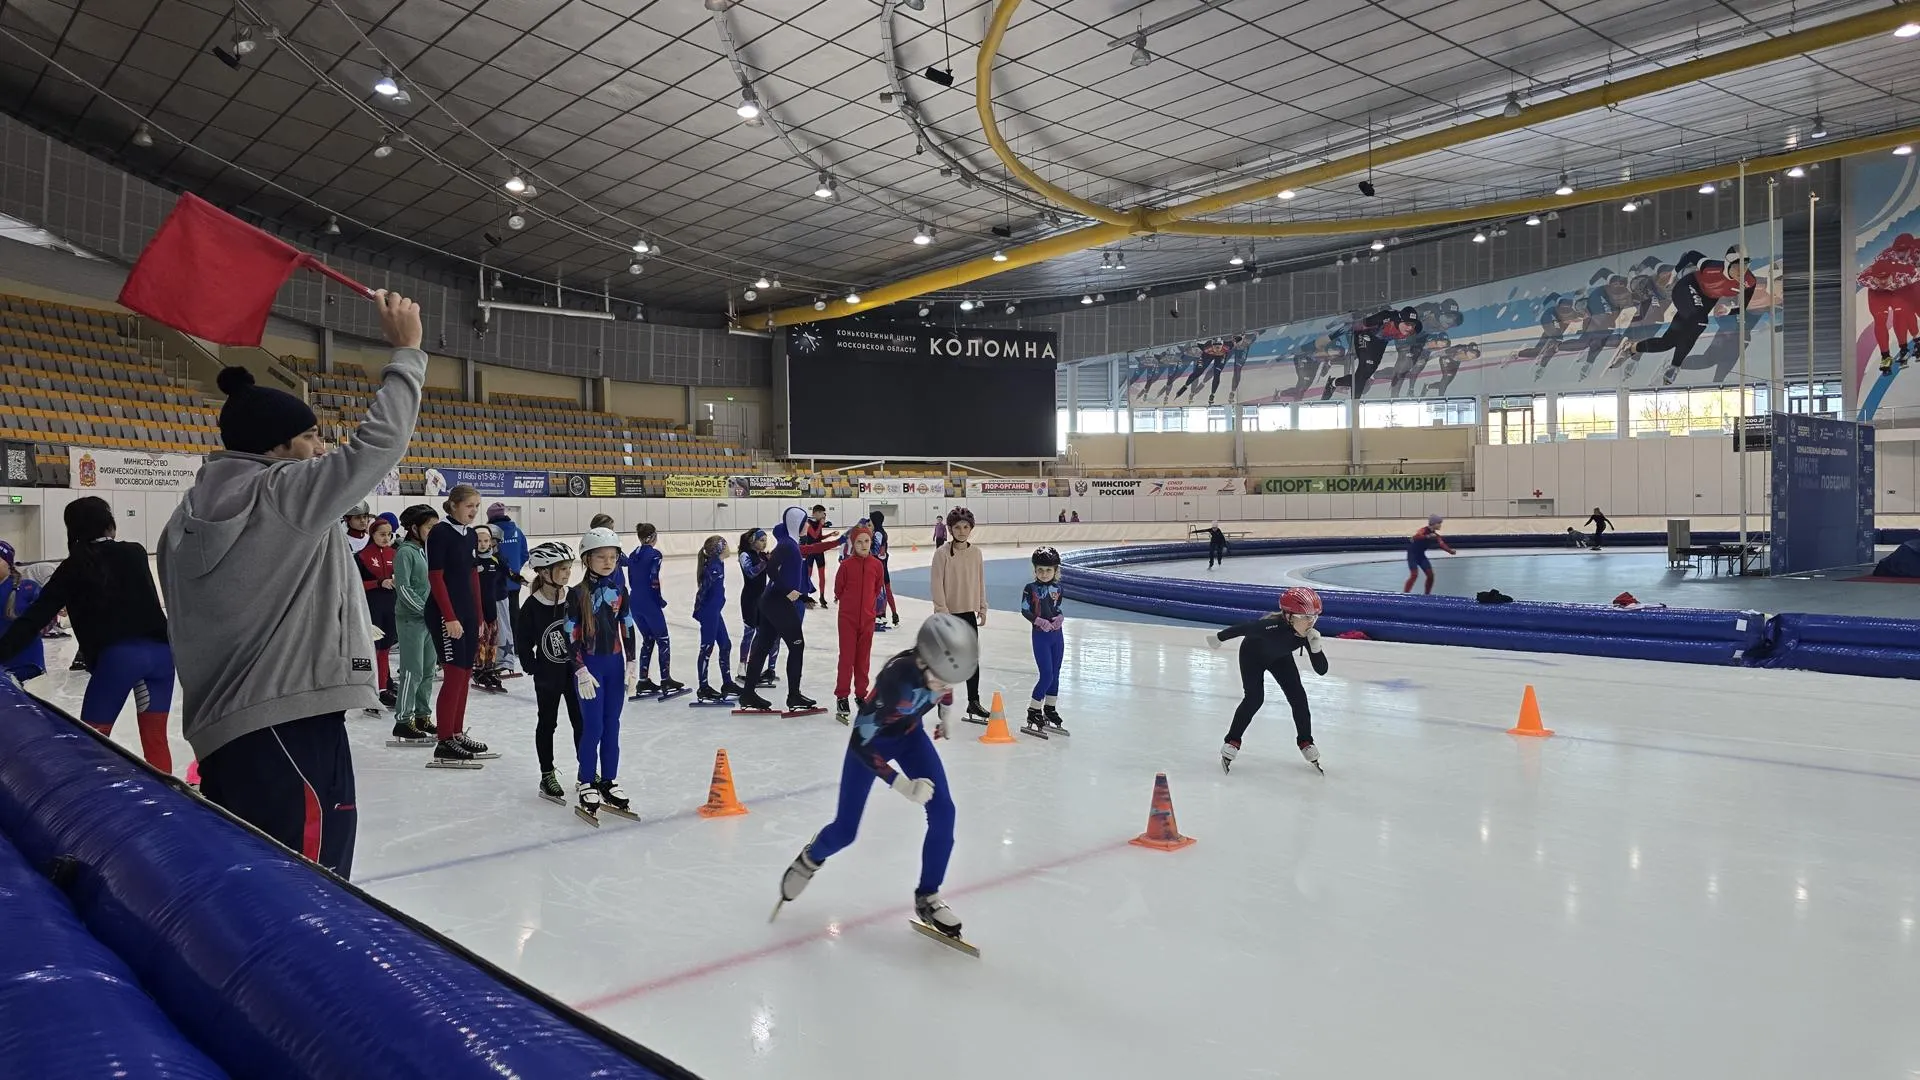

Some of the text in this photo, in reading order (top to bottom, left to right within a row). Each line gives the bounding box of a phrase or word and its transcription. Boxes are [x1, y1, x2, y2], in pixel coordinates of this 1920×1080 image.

[836, 329, 894, 340] КОНЬКОБЕЖНЫЙ
[837, 341, 917, 353] МОСКОВСКОЙ ОБЛАСТИ
[930, 338, 1056, 359] КОЛОМНА
[123, 458, 168, 467] МИНИСТЕРСТВО
[99, 467, 138, 476] ФИЗИЧЕСКОЙ
[138, 469, 166, 477] КУЛЬТУРЫ
[457, 471, 462, 480] 8
[477, 472, 505, 481] 615-56-72
[115, 478, 154, 486] МОСКОВСКОЙ
[513, 480, 545, 489] ВЫСОТА
[695, 480, 727, 488] APPLE?
[1091, 480, 1142, 488] МИНСПОРТ
[1265, 477, 1446, 493] СПОРТ НОРМА ЖИЗНИ
